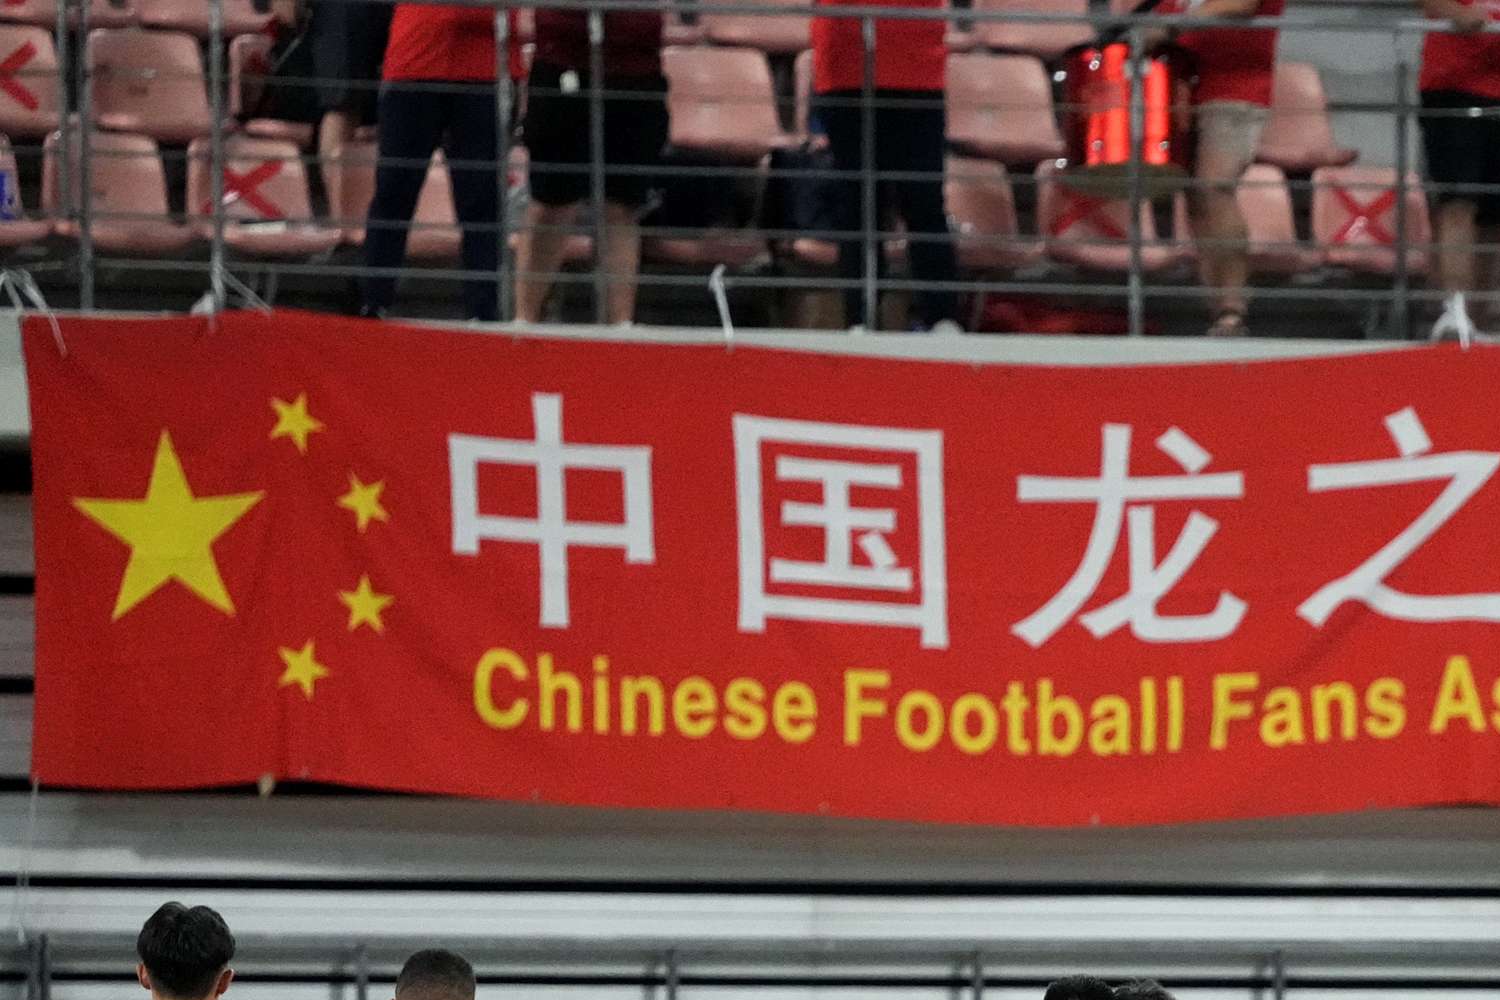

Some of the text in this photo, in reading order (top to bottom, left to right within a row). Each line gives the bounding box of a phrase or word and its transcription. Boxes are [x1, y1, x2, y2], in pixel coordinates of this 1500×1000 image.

[475, 650, 817, 741] Chinese
[845, 670, 1183, 756] Football
[1211, 673, 1405, 749] Fans
